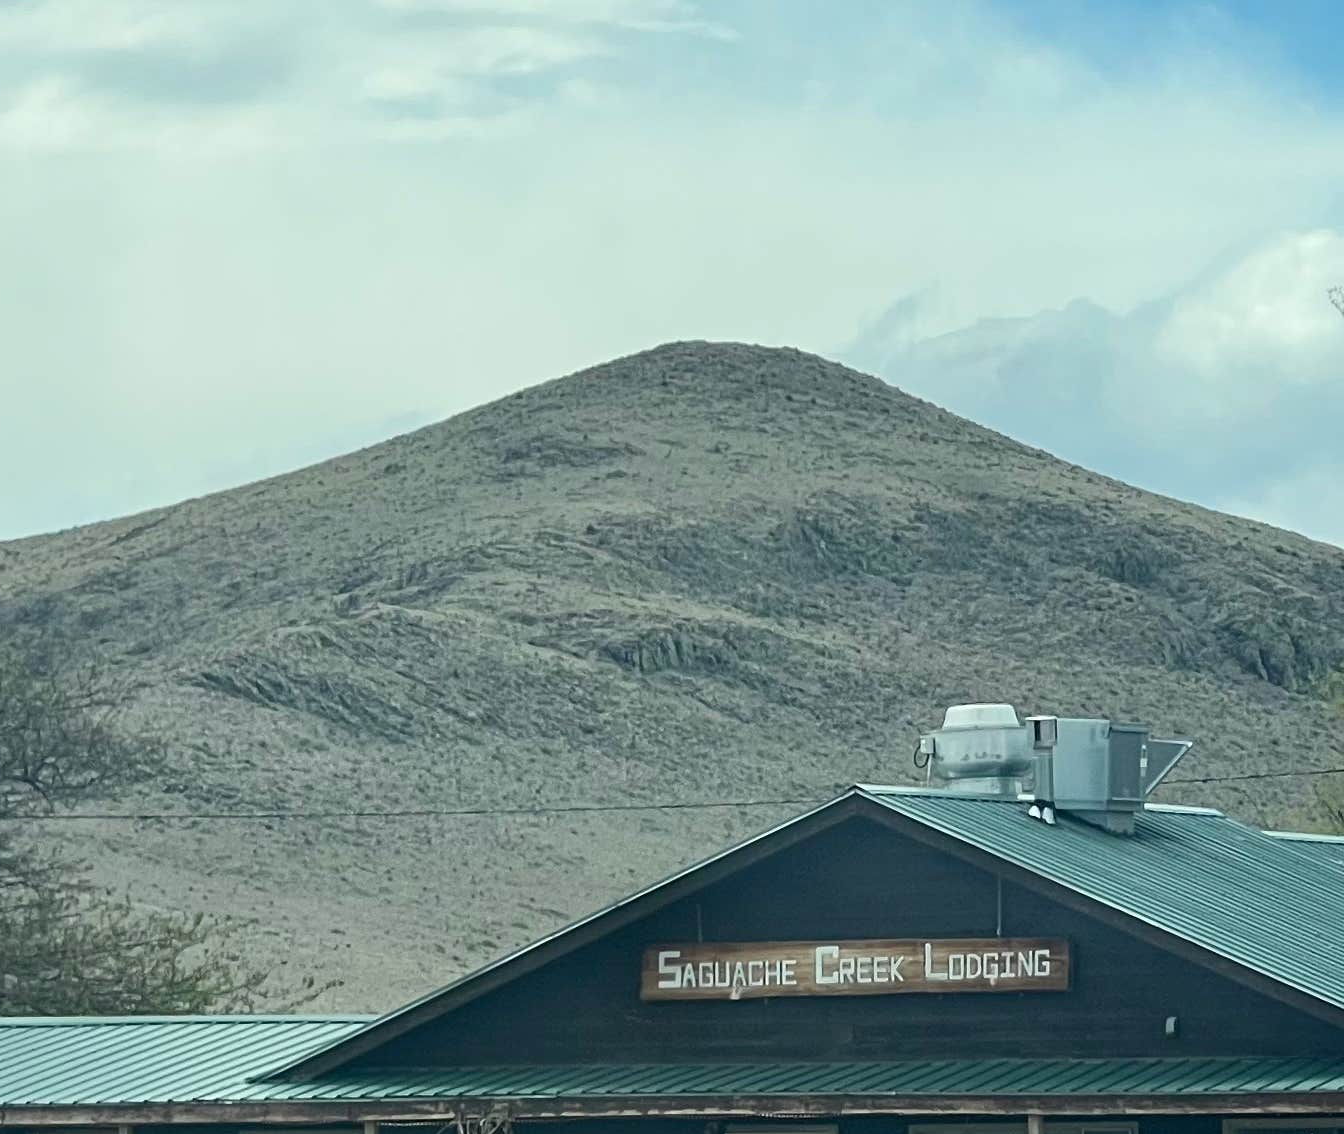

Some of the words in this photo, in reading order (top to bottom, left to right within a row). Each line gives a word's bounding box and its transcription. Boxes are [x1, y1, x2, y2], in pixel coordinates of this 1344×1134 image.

[657, 950, 798, 989] SAGUACHE
[814, 945, 905, 985] CREEK
[924, 942, 1051, 982] LODGING
